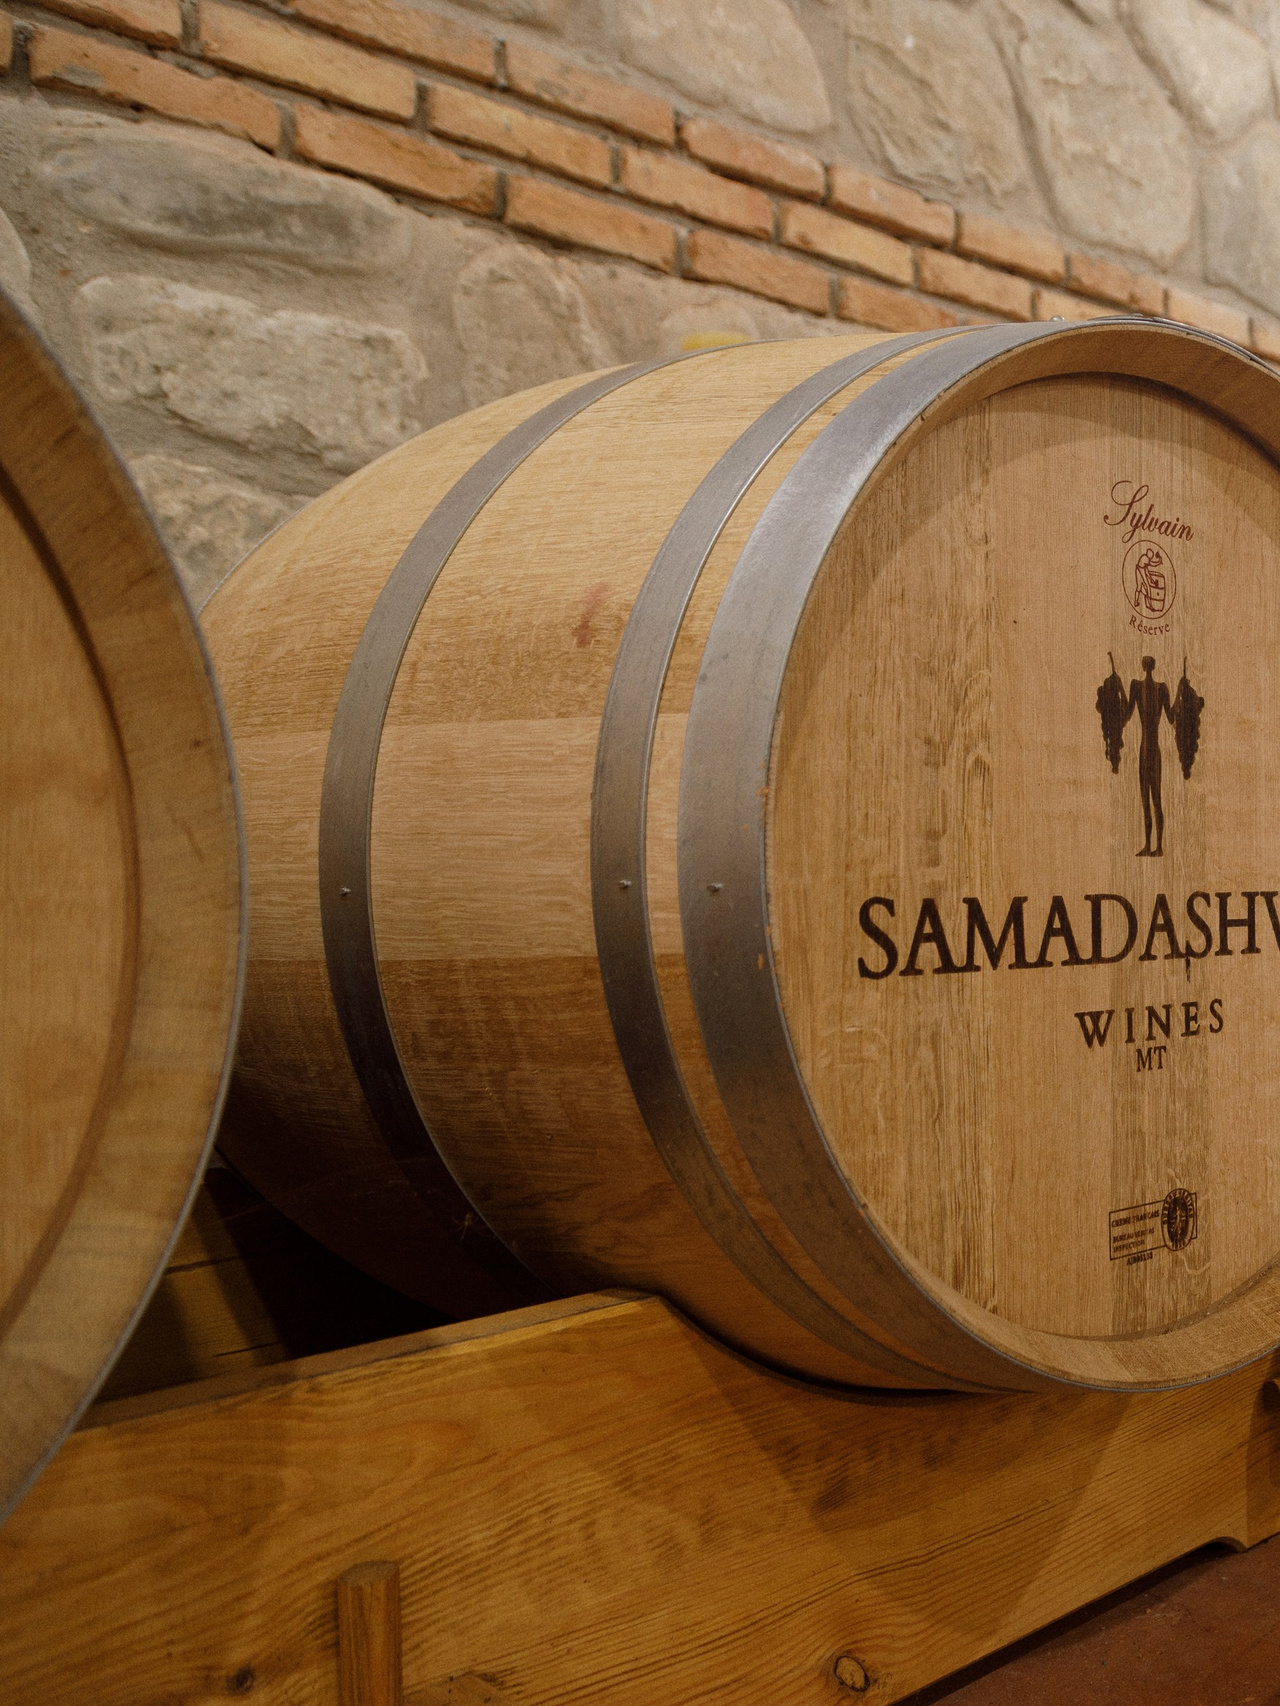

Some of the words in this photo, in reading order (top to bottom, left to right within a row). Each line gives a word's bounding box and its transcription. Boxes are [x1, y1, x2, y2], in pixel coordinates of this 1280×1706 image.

[1103, 480, 1194, 543] Sylvain
[1129, 614, 1171, 635] Réserve
[1074, 998, 1224, 1049] WINES
[1136, 1045, 1167, 1072] MT
